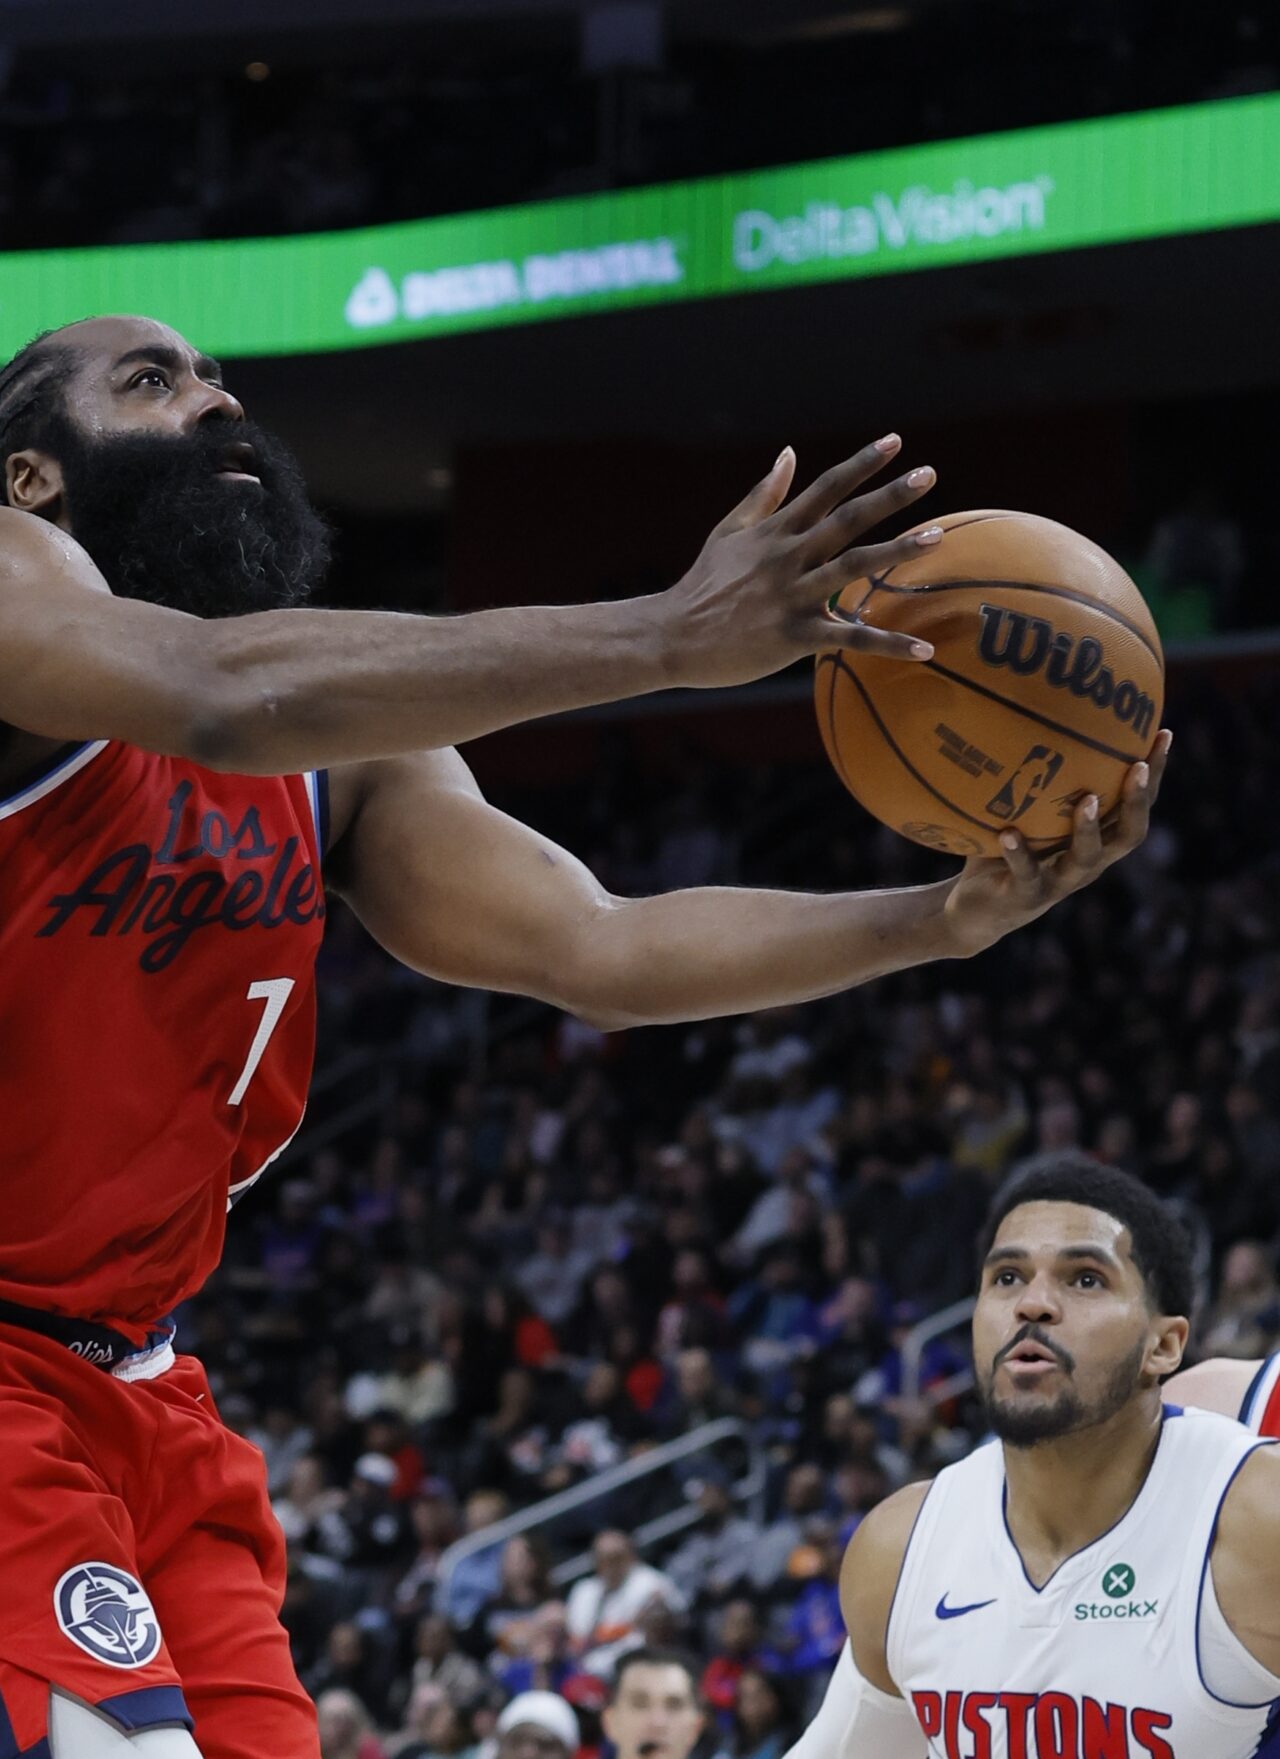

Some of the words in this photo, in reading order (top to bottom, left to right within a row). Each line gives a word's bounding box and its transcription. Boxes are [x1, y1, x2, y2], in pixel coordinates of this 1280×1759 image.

[977, 603, 1155, 742] Wilson
[154, 779, 279, 864] Los
[34, 836, 326, 974] Angele
[1074, 1600, 1159, 1621] StockX
[910, 1691, 1176, 1759] PISTONS
